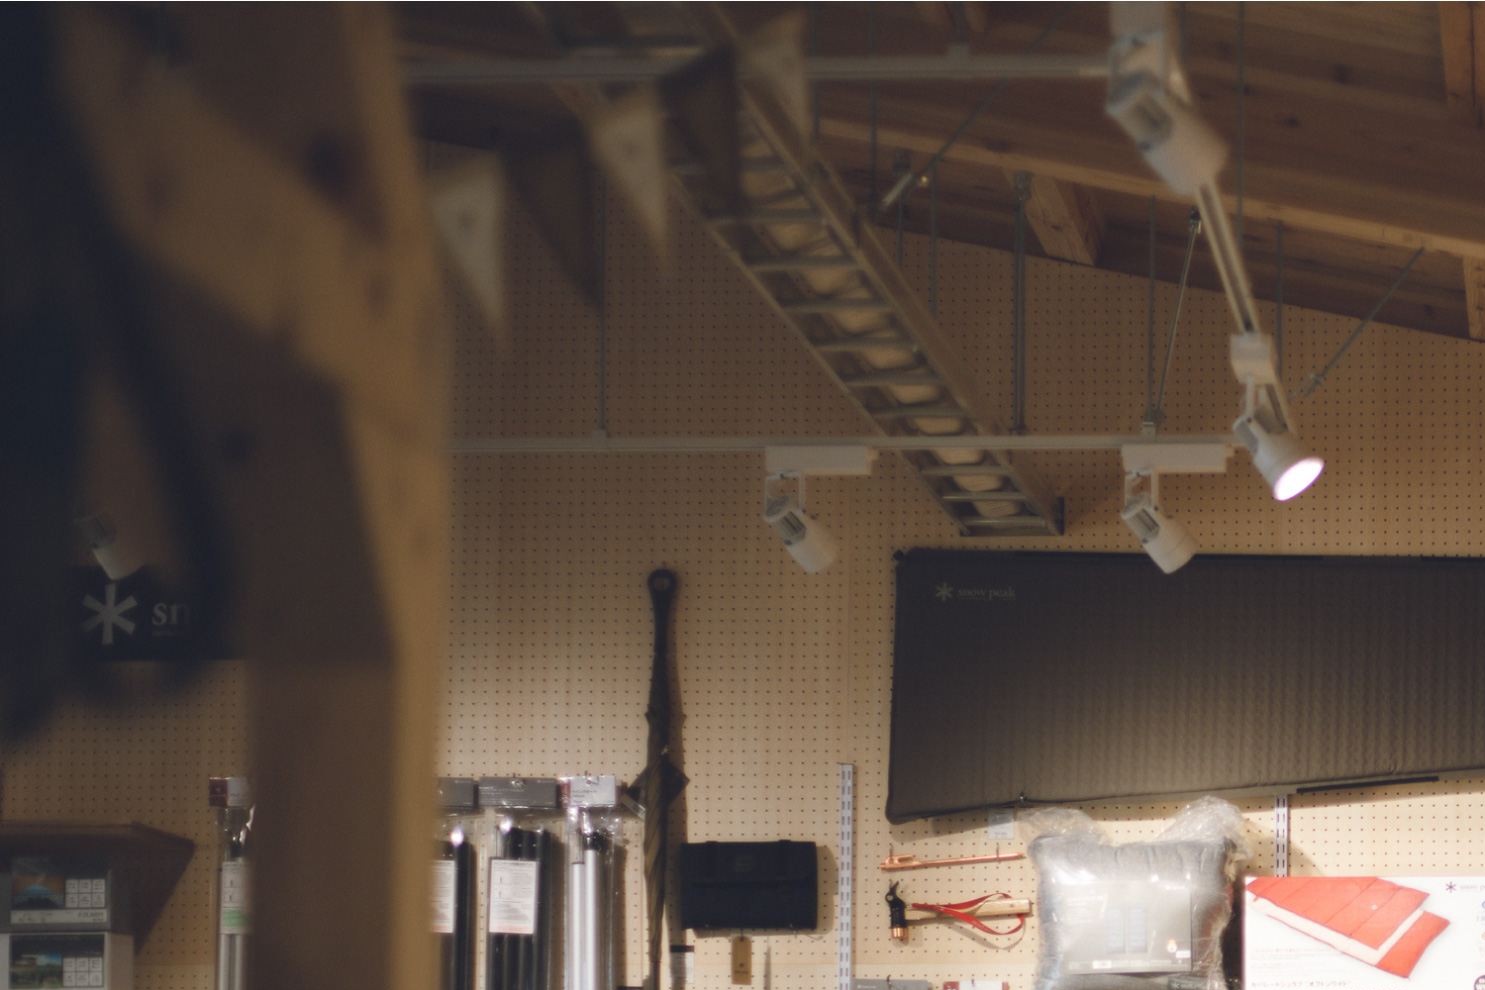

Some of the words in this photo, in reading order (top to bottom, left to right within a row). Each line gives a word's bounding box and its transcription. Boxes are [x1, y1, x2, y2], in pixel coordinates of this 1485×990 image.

[957, 589, 987, 598] snow
[989, 586, 1016, 600] peak
[151, 601, 192, 627] sn
